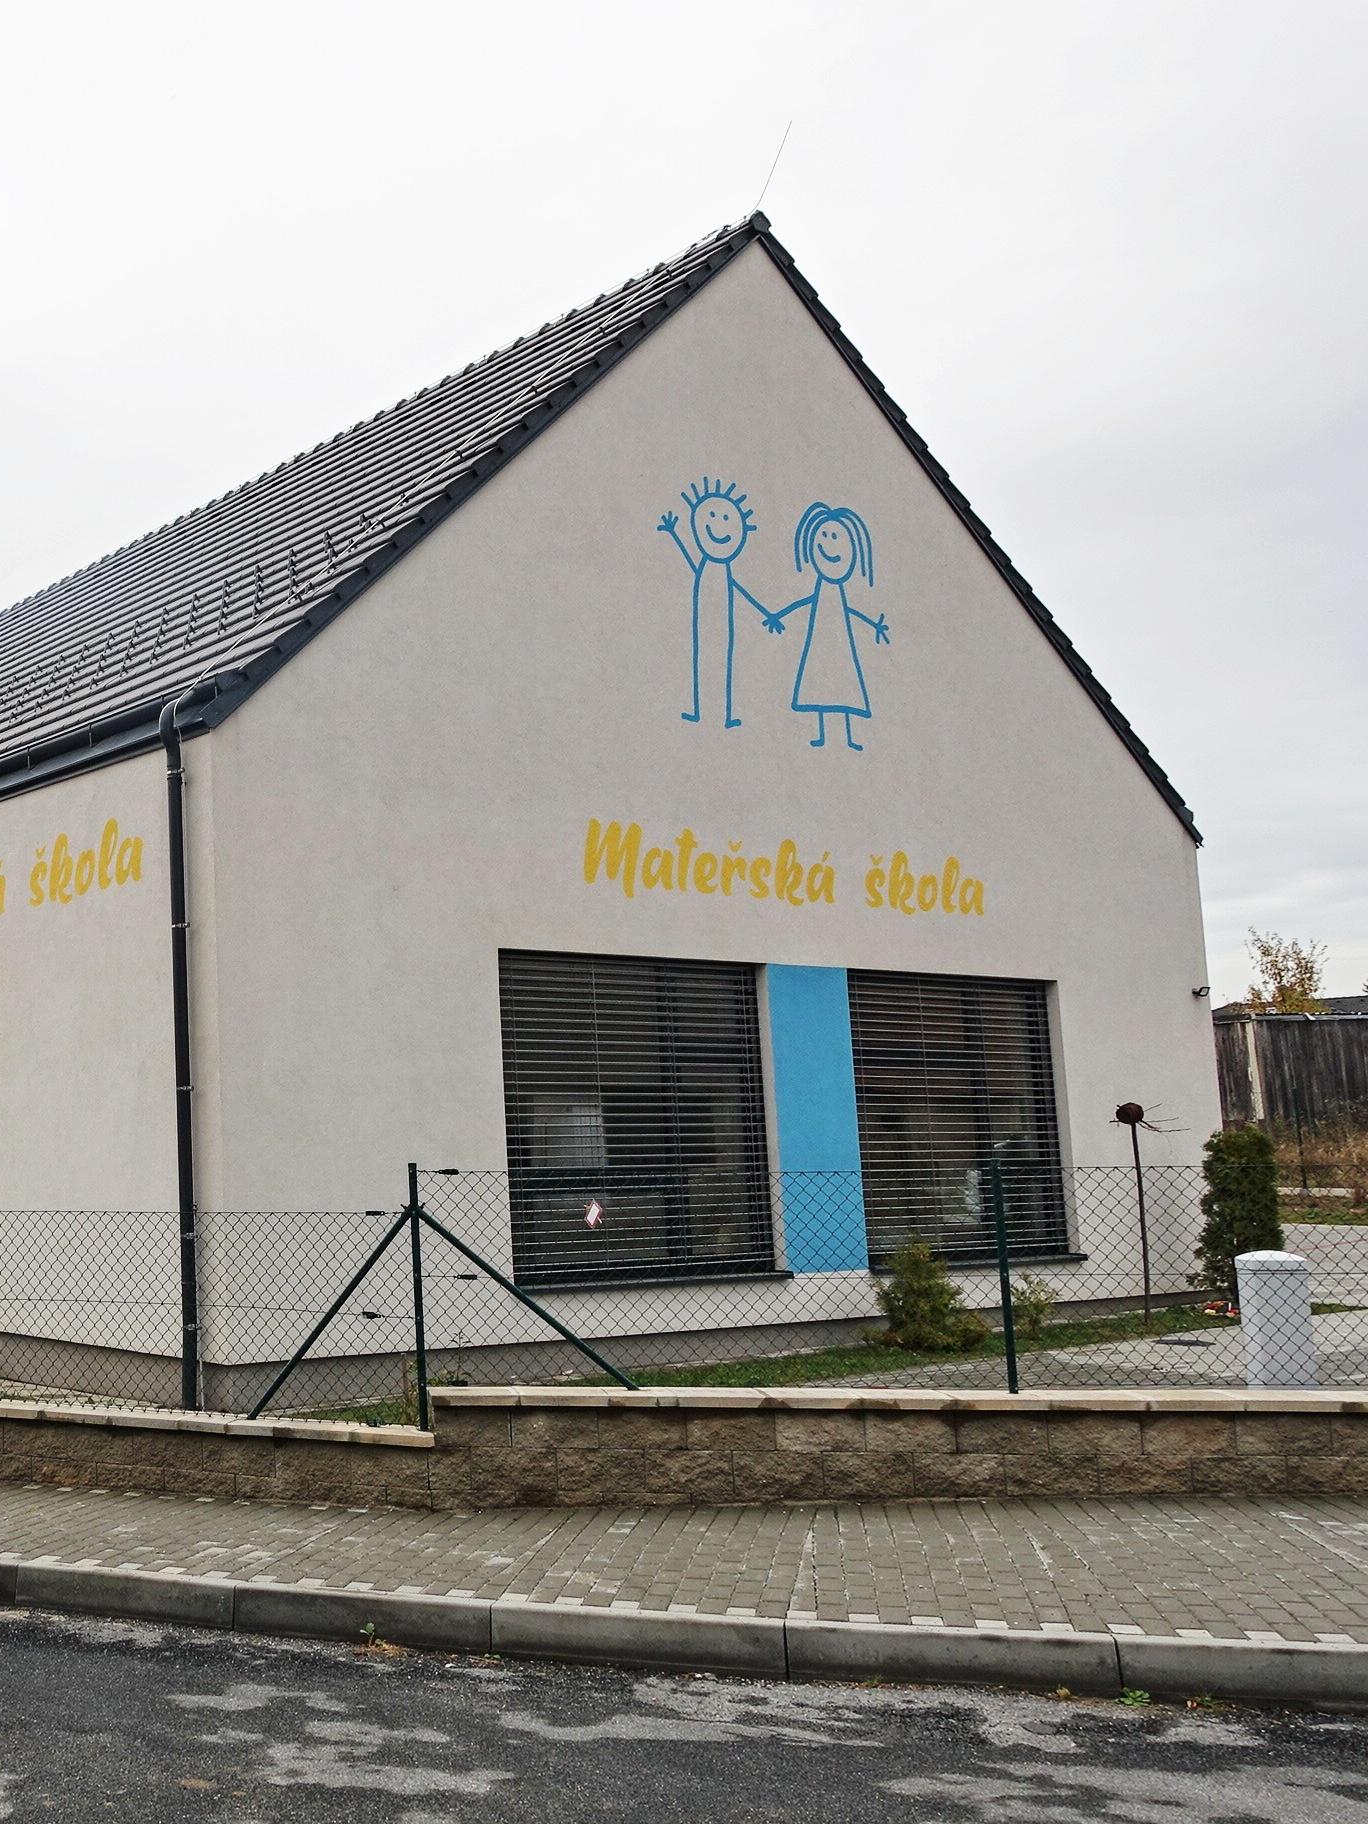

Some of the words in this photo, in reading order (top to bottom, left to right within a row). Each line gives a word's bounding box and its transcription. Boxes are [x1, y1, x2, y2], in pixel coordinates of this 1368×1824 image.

[29, 817, 144, 907] škola
[583, 817, 836, 906] Mateřská
[864, 850, 985, 916] škola
